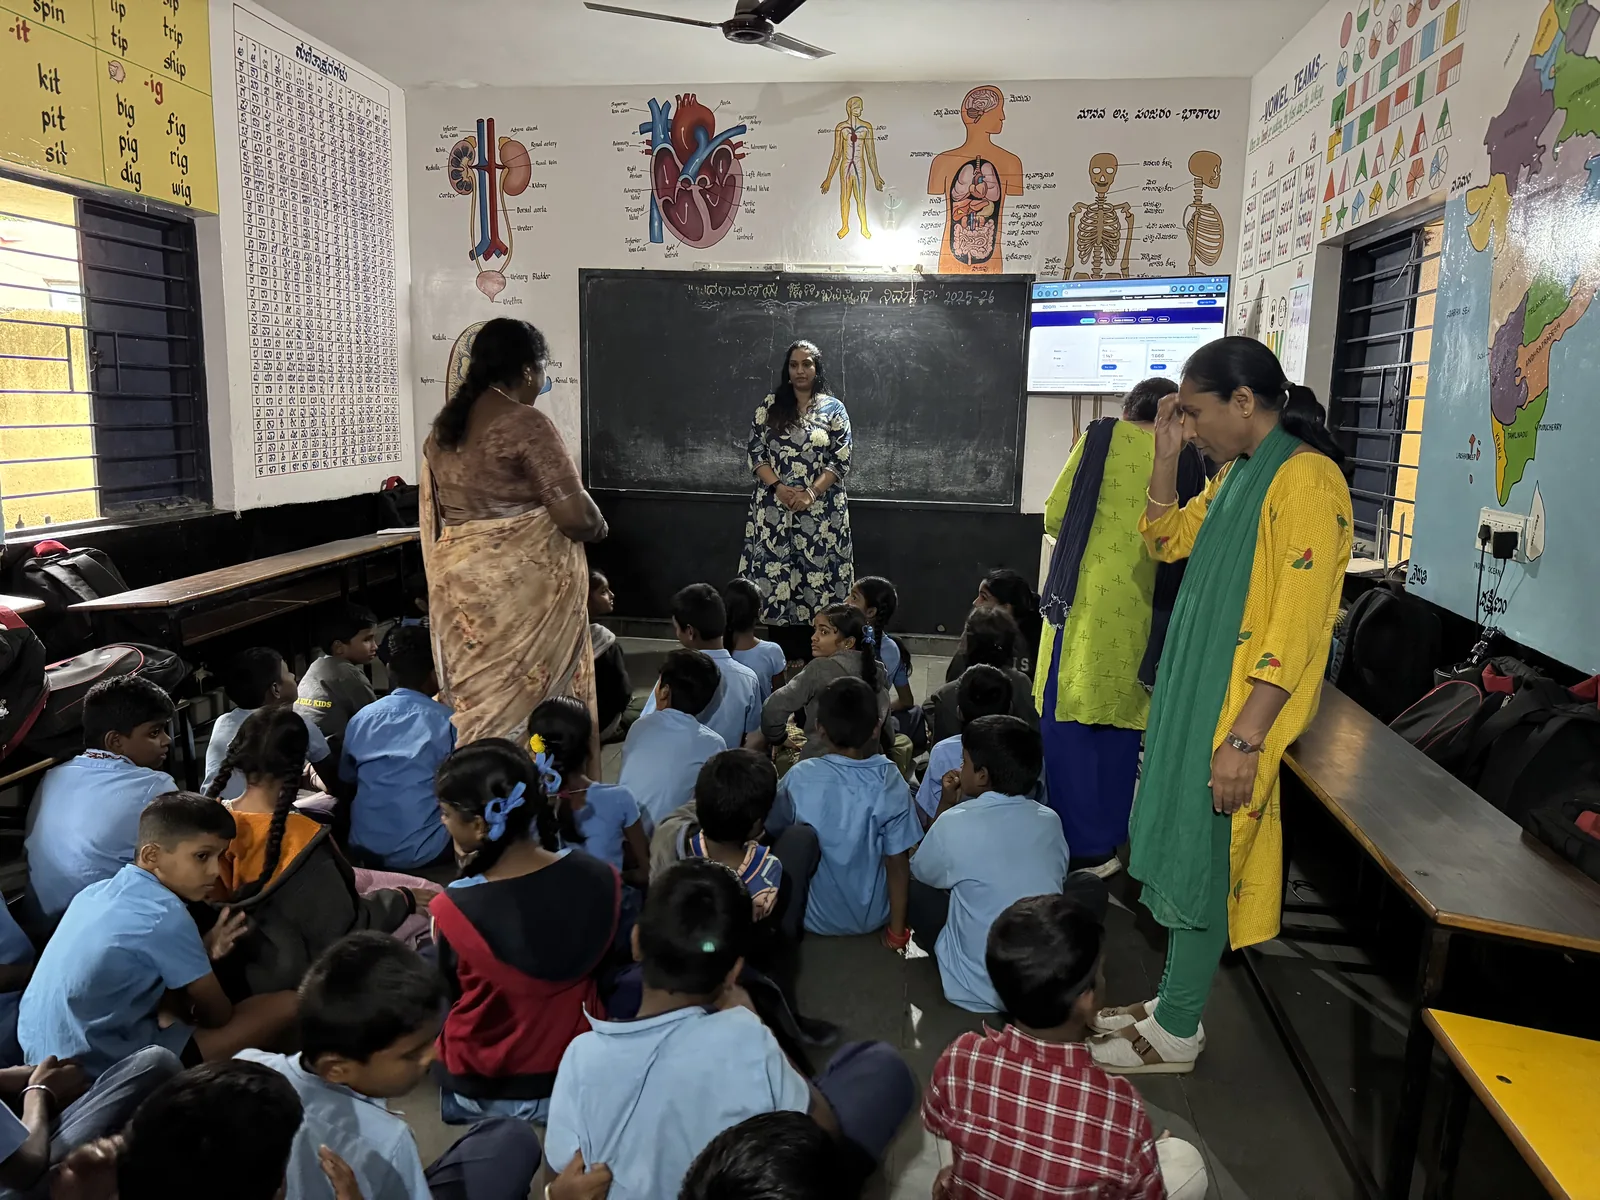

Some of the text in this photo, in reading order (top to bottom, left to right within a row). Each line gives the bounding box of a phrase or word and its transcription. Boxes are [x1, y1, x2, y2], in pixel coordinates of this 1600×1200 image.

[33, 0, 65, 24] spin
[9, 17, 31, 43] -it
[111, 26, 128, 56] tip
[163, 17, 183, 49] trip
[38, 63, 61, 94] kit
[164, 51, 186, 80] ship
[144, 74, 164, 105] -ig
[1264, 84, 1288, 121] VOWEL
[1294, 53, 1320, 96] TEAMS
[41, 106, 66, 133] pit
[116, 93, 135, 128] big
[166, 112, 186, 144] fig
[45, 140, 67, 165] sit
[119, 131, 138, 162] pig
[170, 147, 188, 175] rig
[1305, 162, 1315, 182] key
[121, 161, 142, 192] dig
[172, 179, 191, 206] wig
[532, 272, 551, 280] Bladder
[944, 290, 995, 304] 2025-26
[313, 699, 332, 708] KIDS
